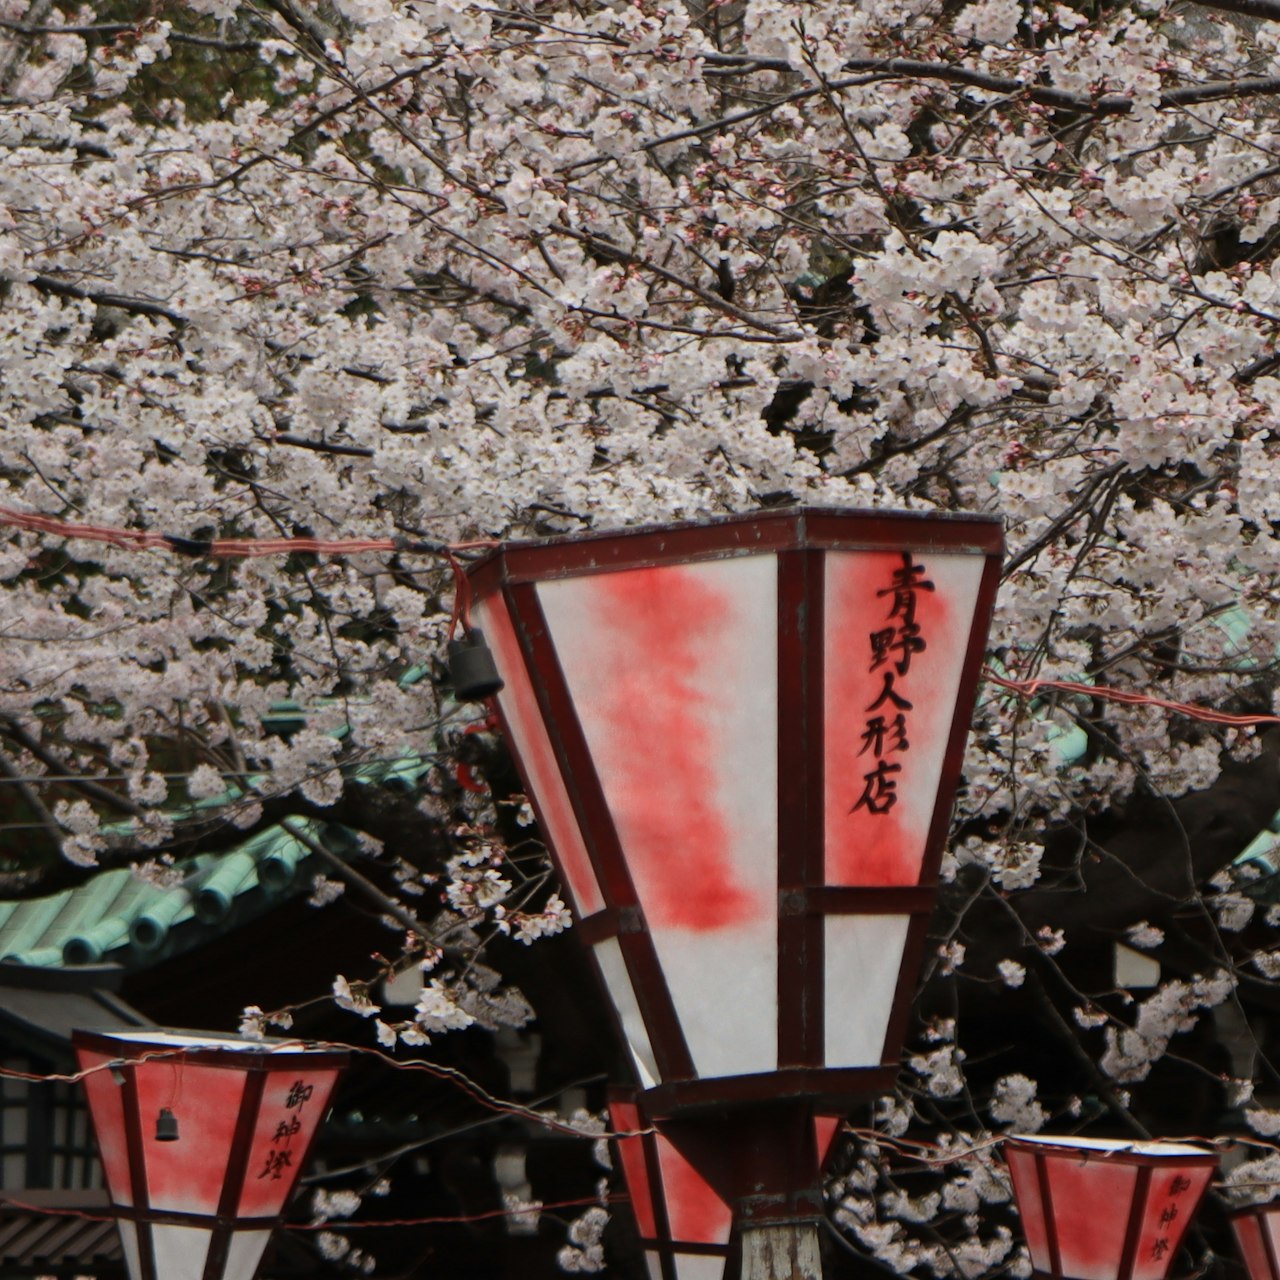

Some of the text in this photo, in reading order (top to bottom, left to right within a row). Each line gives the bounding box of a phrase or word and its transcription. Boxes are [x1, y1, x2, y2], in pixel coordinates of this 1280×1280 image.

[848, 551, 936, 815] 青野人形店
[257, 1079, 315, 1181] 御神燈
